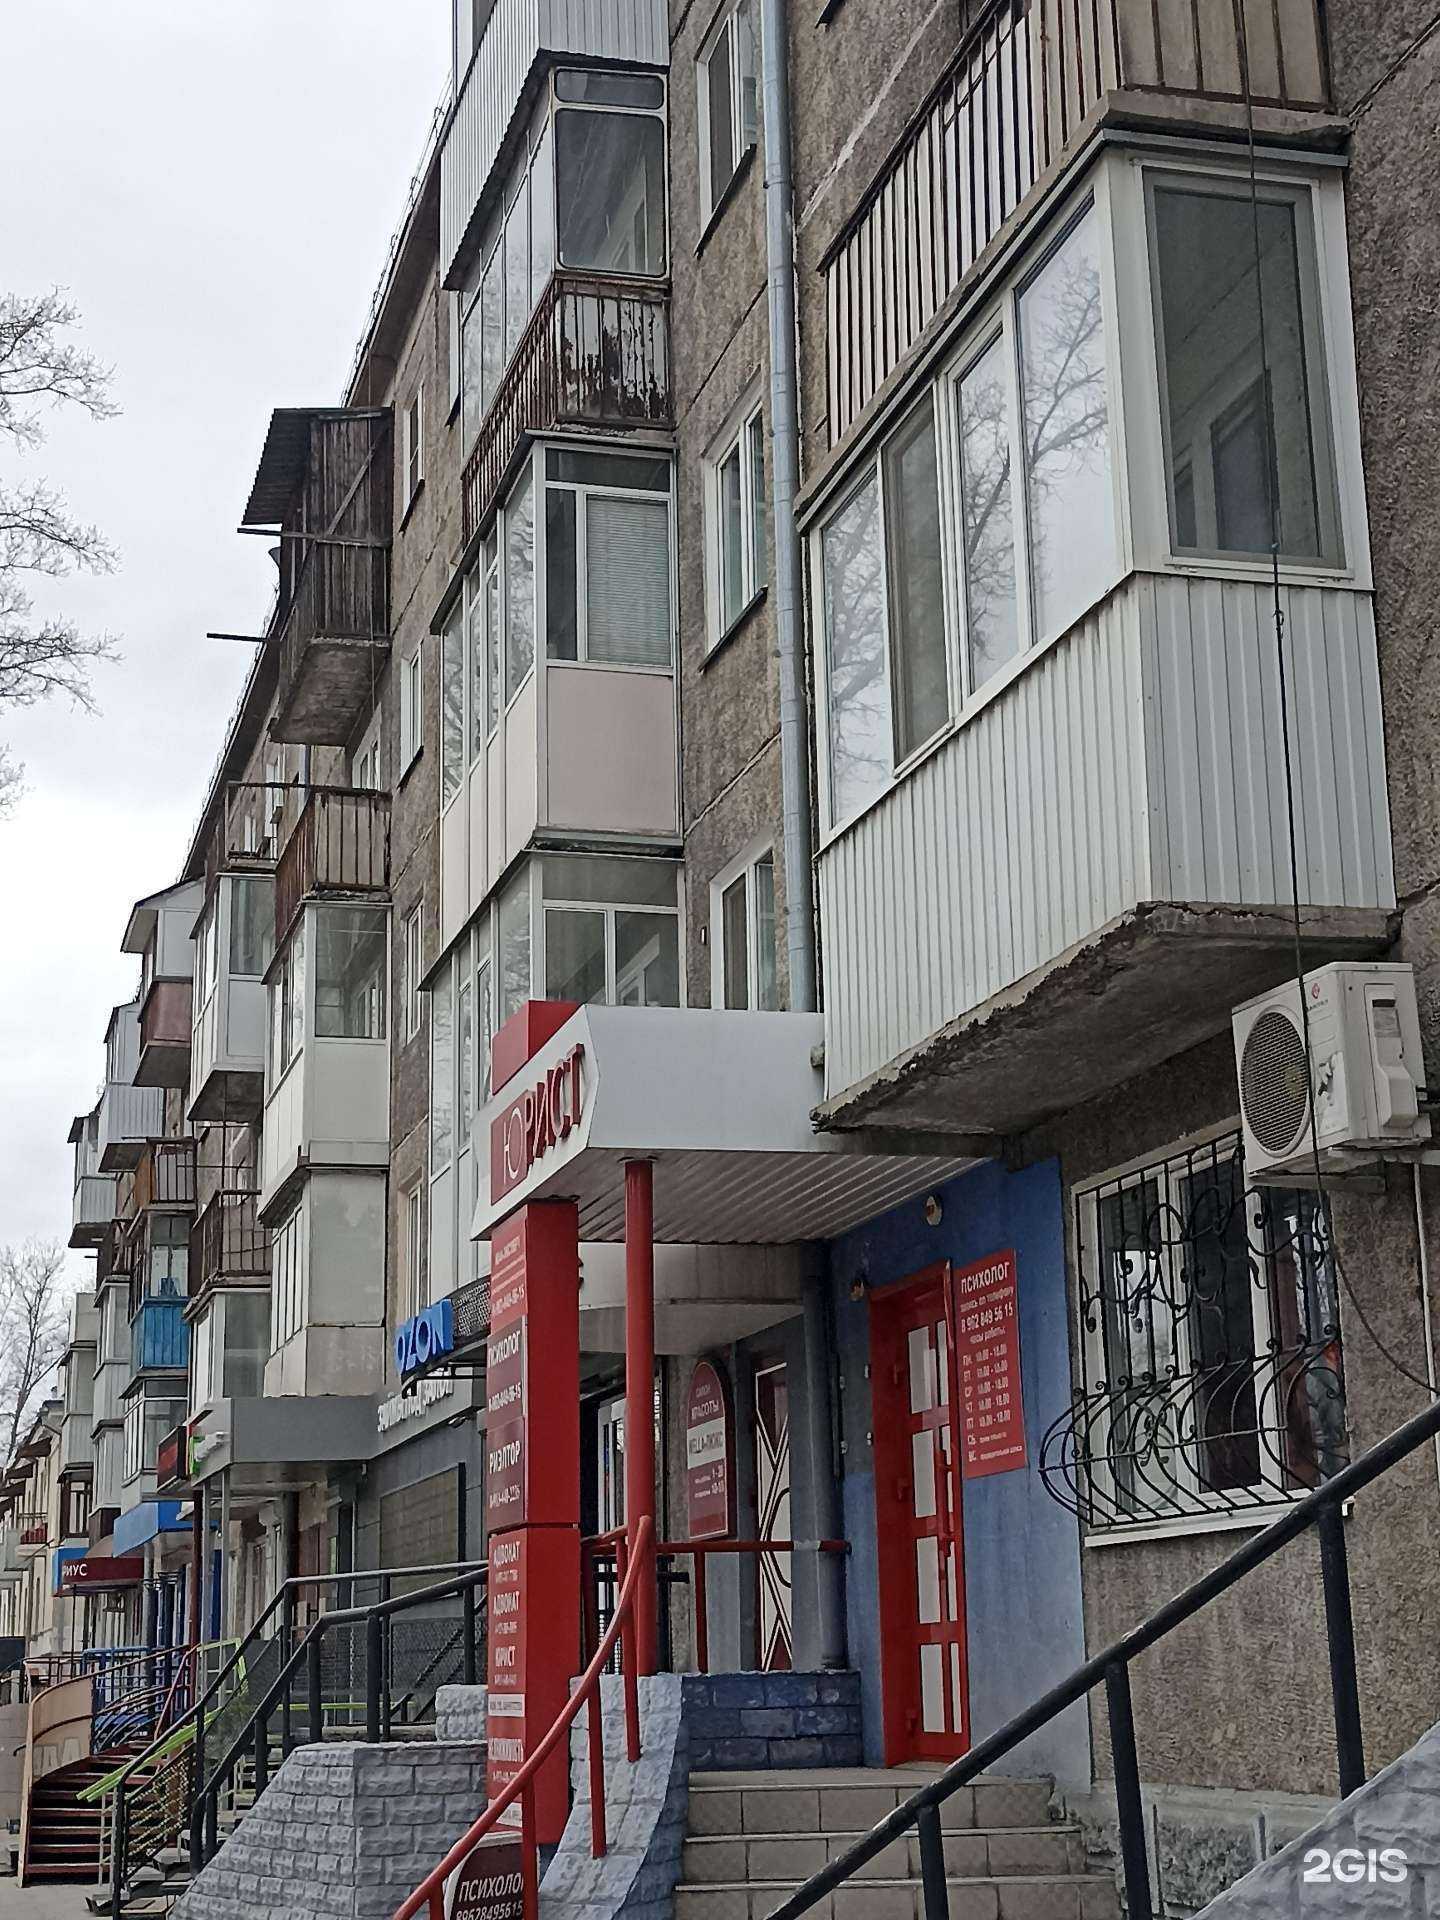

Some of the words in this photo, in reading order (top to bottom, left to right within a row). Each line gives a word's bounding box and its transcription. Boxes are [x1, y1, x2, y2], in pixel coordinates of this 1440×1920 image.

[503, 1042, 586, 1184] ЮРИСТ
[961, 1261, 1010, 1294] ПСИХОЛОГ
[961, 1318, 966, 1333] 8
[994, 1305, 1004, 1321] 56
[1004, 1302, 1013, 1317] 15
[394, 1297, 455, 1376] OZON
[489, 1440, 521, 1475] РИЭЛТОР
[493, 1540, 520, 1568] АДВОКАТ
[493, 1590, 520, 1617] АДВОКАТ
[495, 1645, 516, 1667] ЮРИСТ
[458, 1872, 524, 1903] ПСИХОЛО
